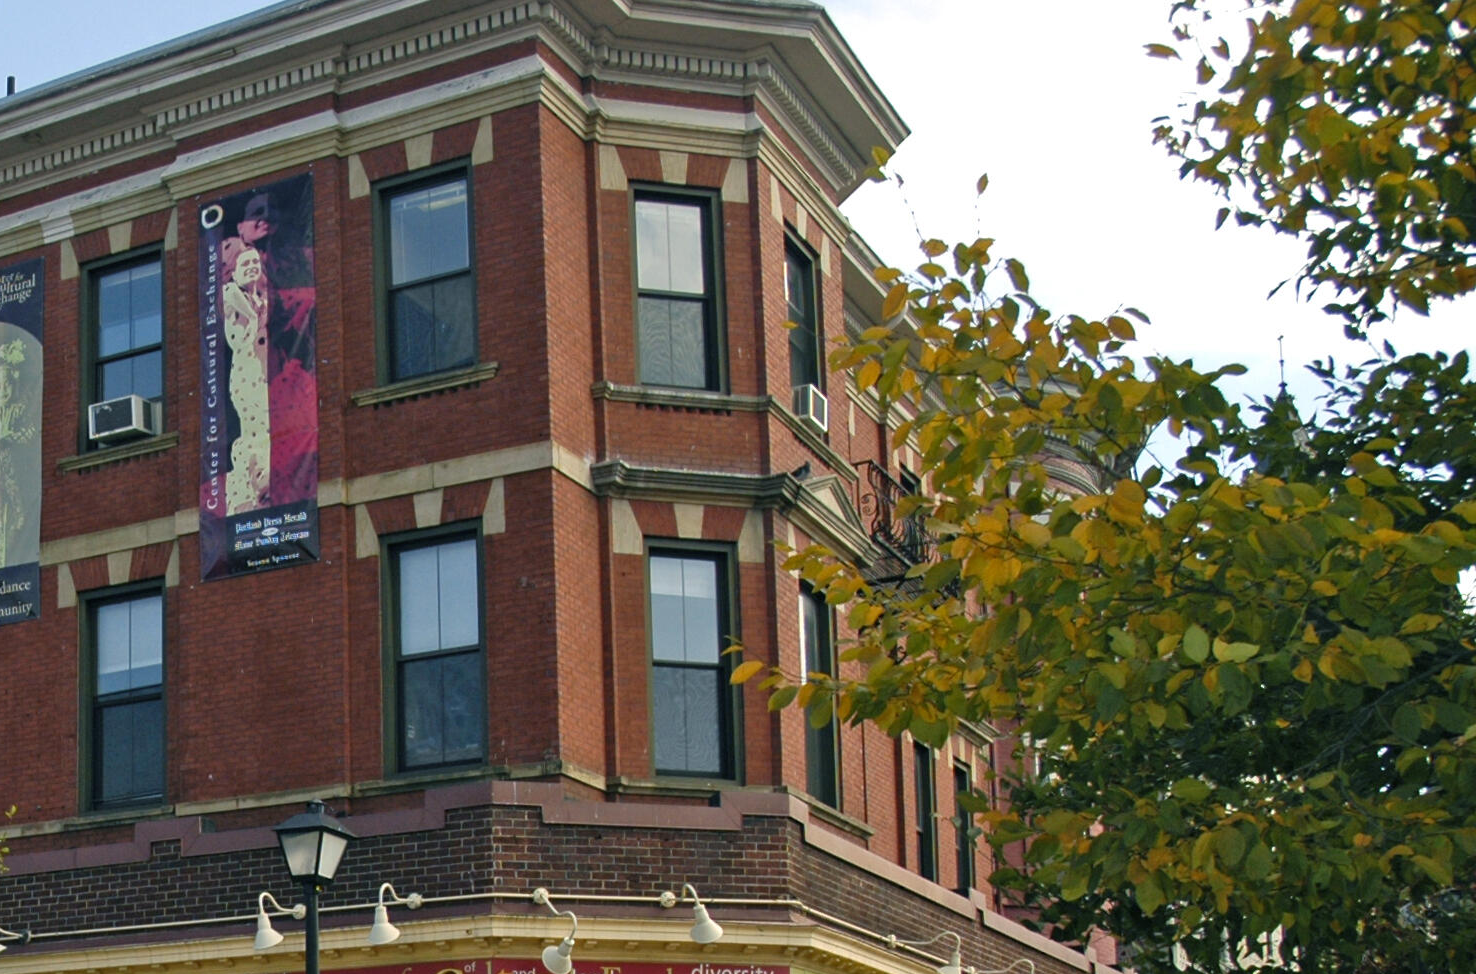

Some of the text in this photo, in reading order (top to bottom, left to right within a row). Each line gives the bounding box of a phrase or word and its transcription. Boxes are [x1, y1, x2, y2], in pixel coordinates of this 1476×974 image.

[206, 245, 219, 510] Center for Cultural Exchange
[0, 580, 31, 595] dance
[464, 961, 476, 973] of
